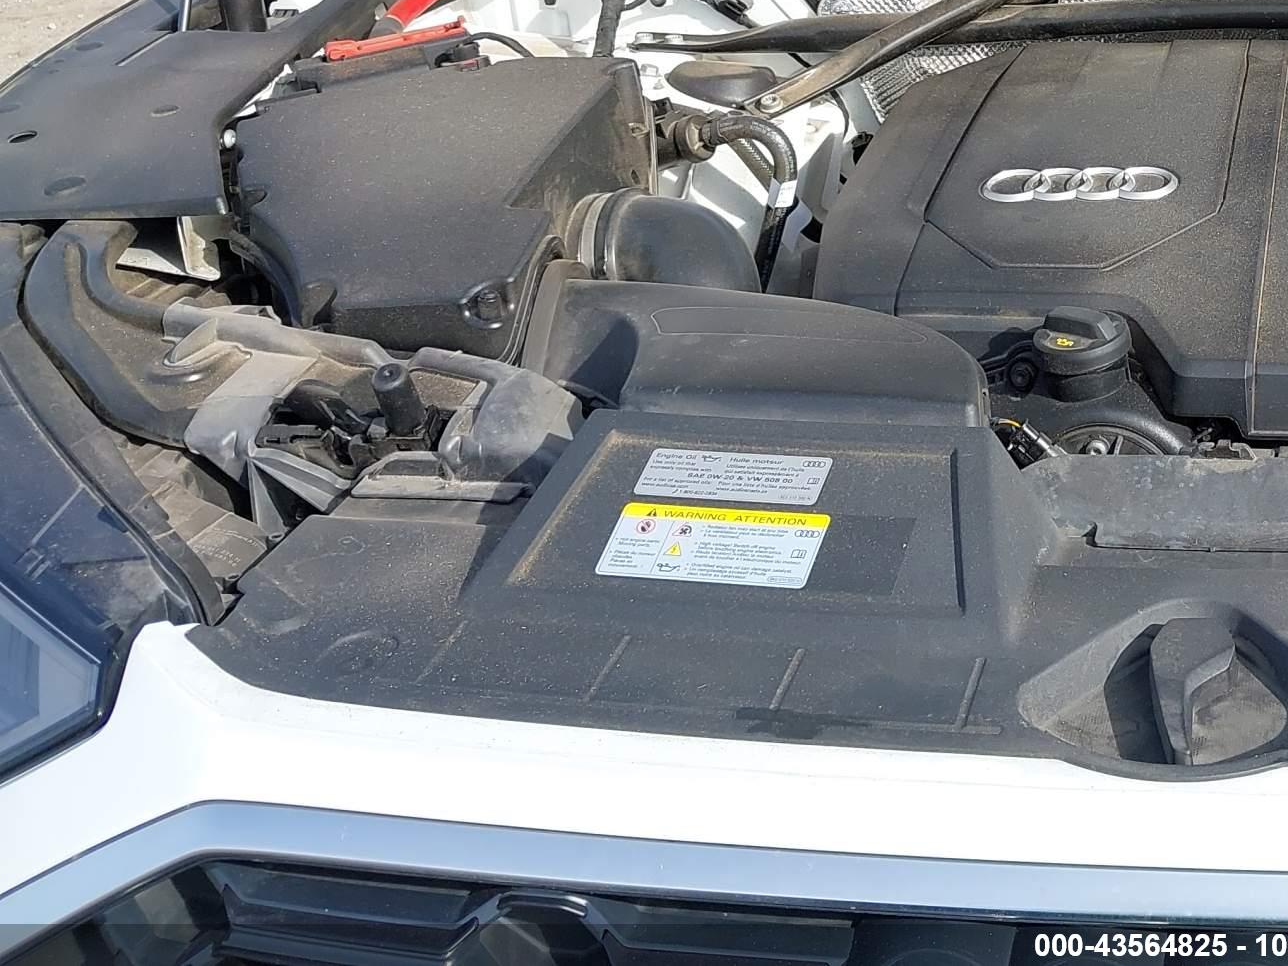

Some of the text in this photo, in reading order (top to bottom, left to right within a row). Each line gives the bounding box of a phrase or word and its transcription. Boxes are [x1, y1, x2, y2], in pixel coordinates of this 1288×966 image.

[656, 452, 698, 461] Engine Oil
[707, 473, 734, 481] 0W-20
[664, 510, 807, 526] WARNING ATTENTION
